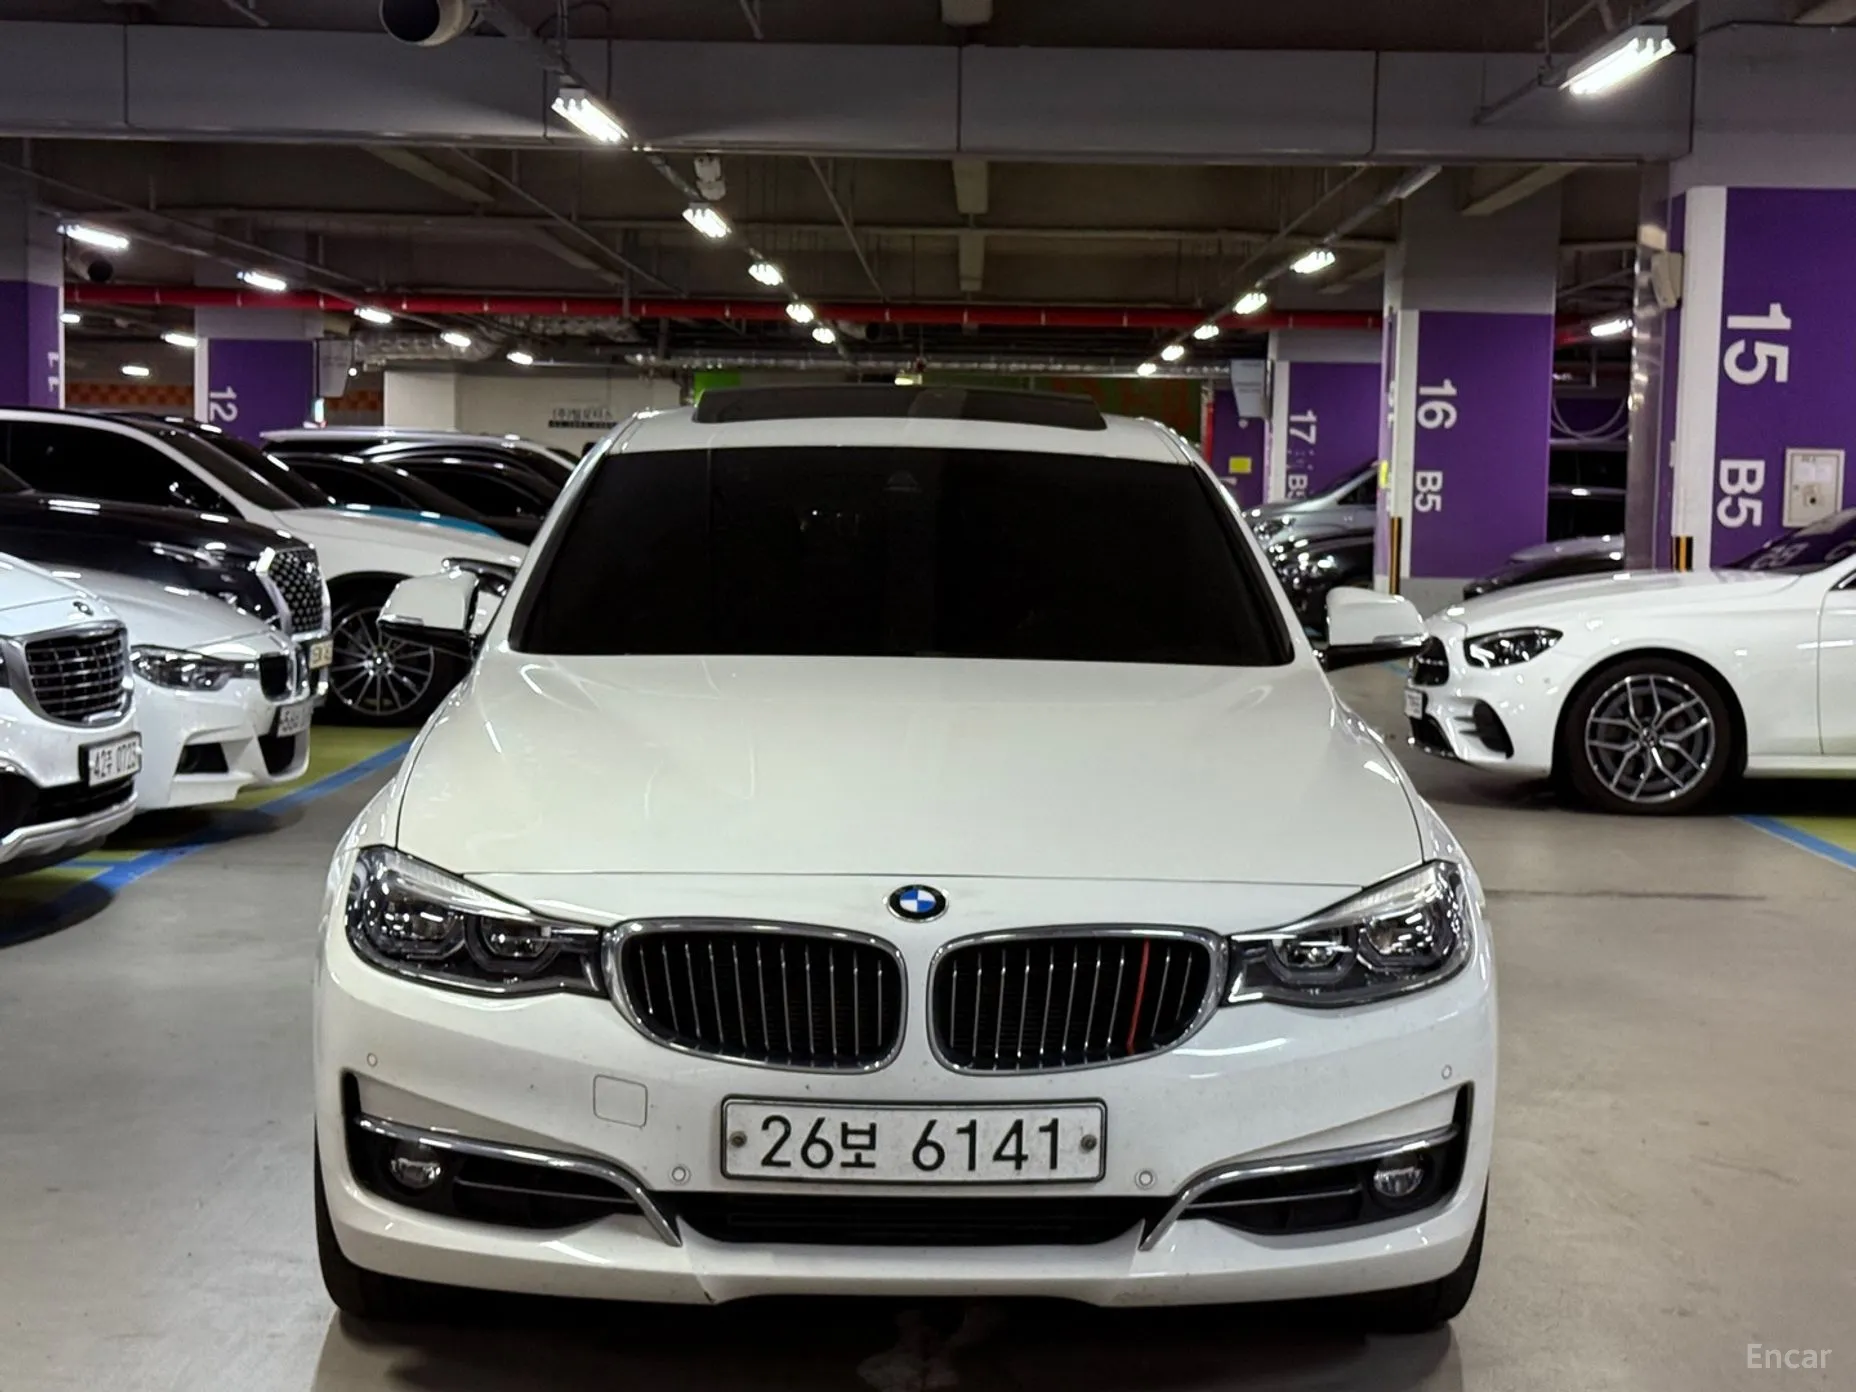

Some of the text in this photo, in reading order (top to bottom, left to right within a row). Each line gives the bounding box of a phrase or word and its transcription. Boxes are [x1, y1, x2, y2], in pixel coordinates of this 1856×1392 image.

[1724, 303, 1792, 385] 15
[209, 386, 238, 422] 12
[1289, 410, 1318, 445] 17
[1417, 379, 1458, 429] 16
[1414, 470, 1444, 512] B5
[1716, 459, 1766, 528] B5
[760, 1114, 1060, 1172] 26보 6141
